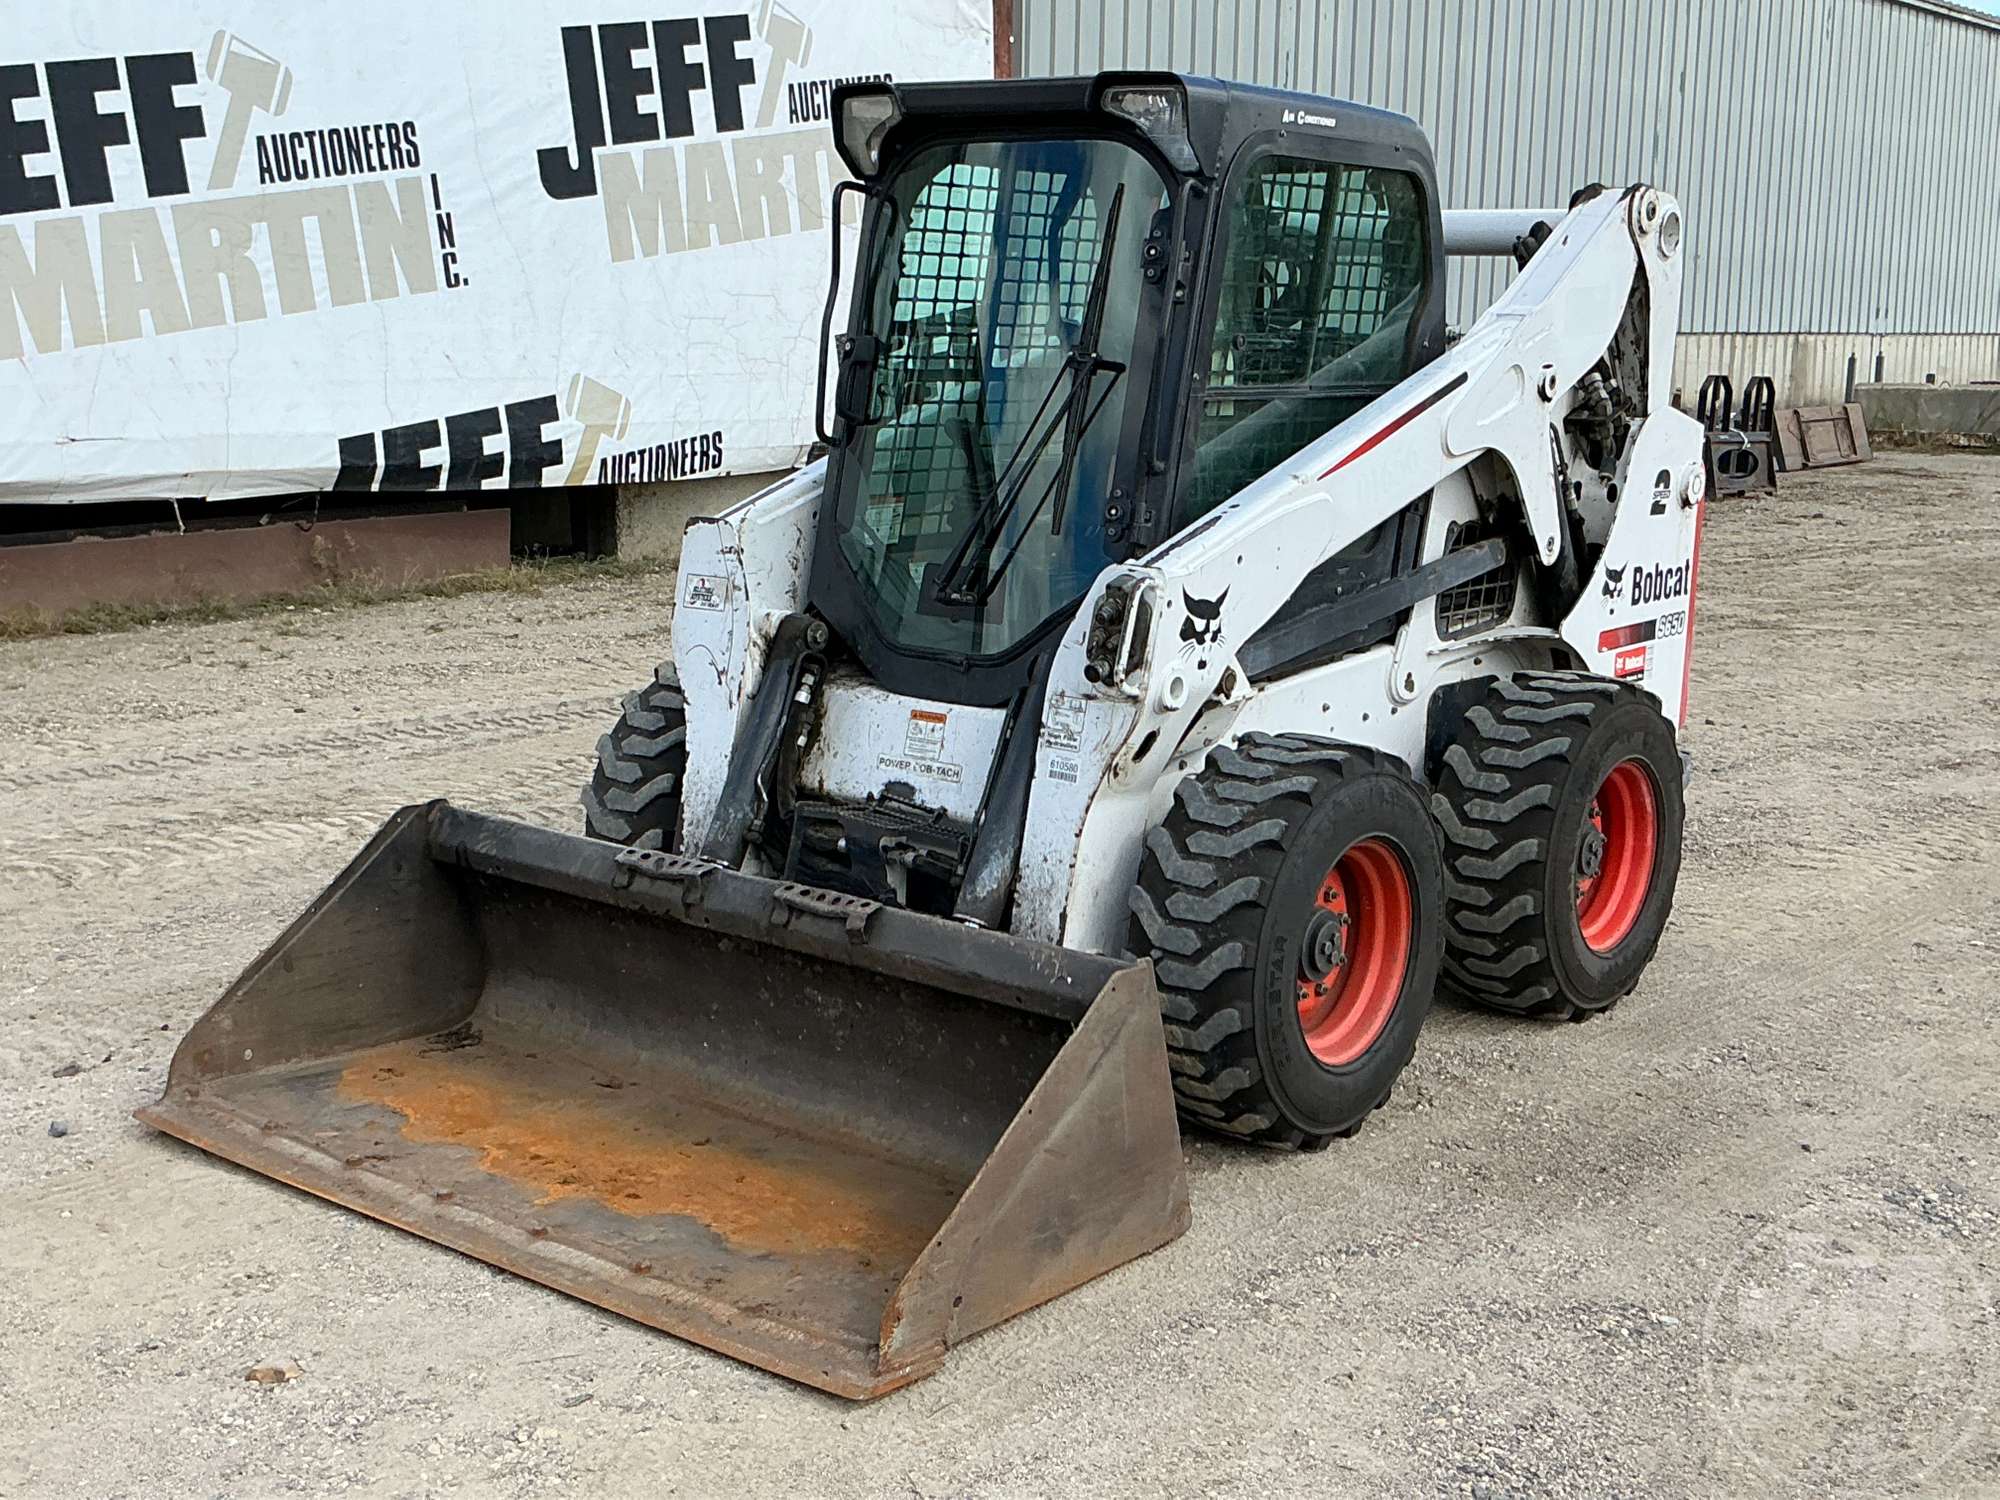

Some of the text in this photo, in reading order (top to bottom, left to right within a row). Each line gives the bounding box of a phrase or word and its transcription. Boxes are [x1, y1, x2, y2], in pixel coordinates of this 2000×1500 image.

[0, 51, 207, 215] EFF
[536, 14, 756, 200] JEFF
[256, 120, 421, 185] AUCTIONEERS
[430, 173, 469, 289] INC.
[0, 176, 438, 361] MARTIN
[598, 430, 723, 485] AUCTIONEERS
[1650, 468, 1671, 516] 2
[1631, 558, 1690, 607] Bobcat
[1657, 610, 1686, 640] S650
